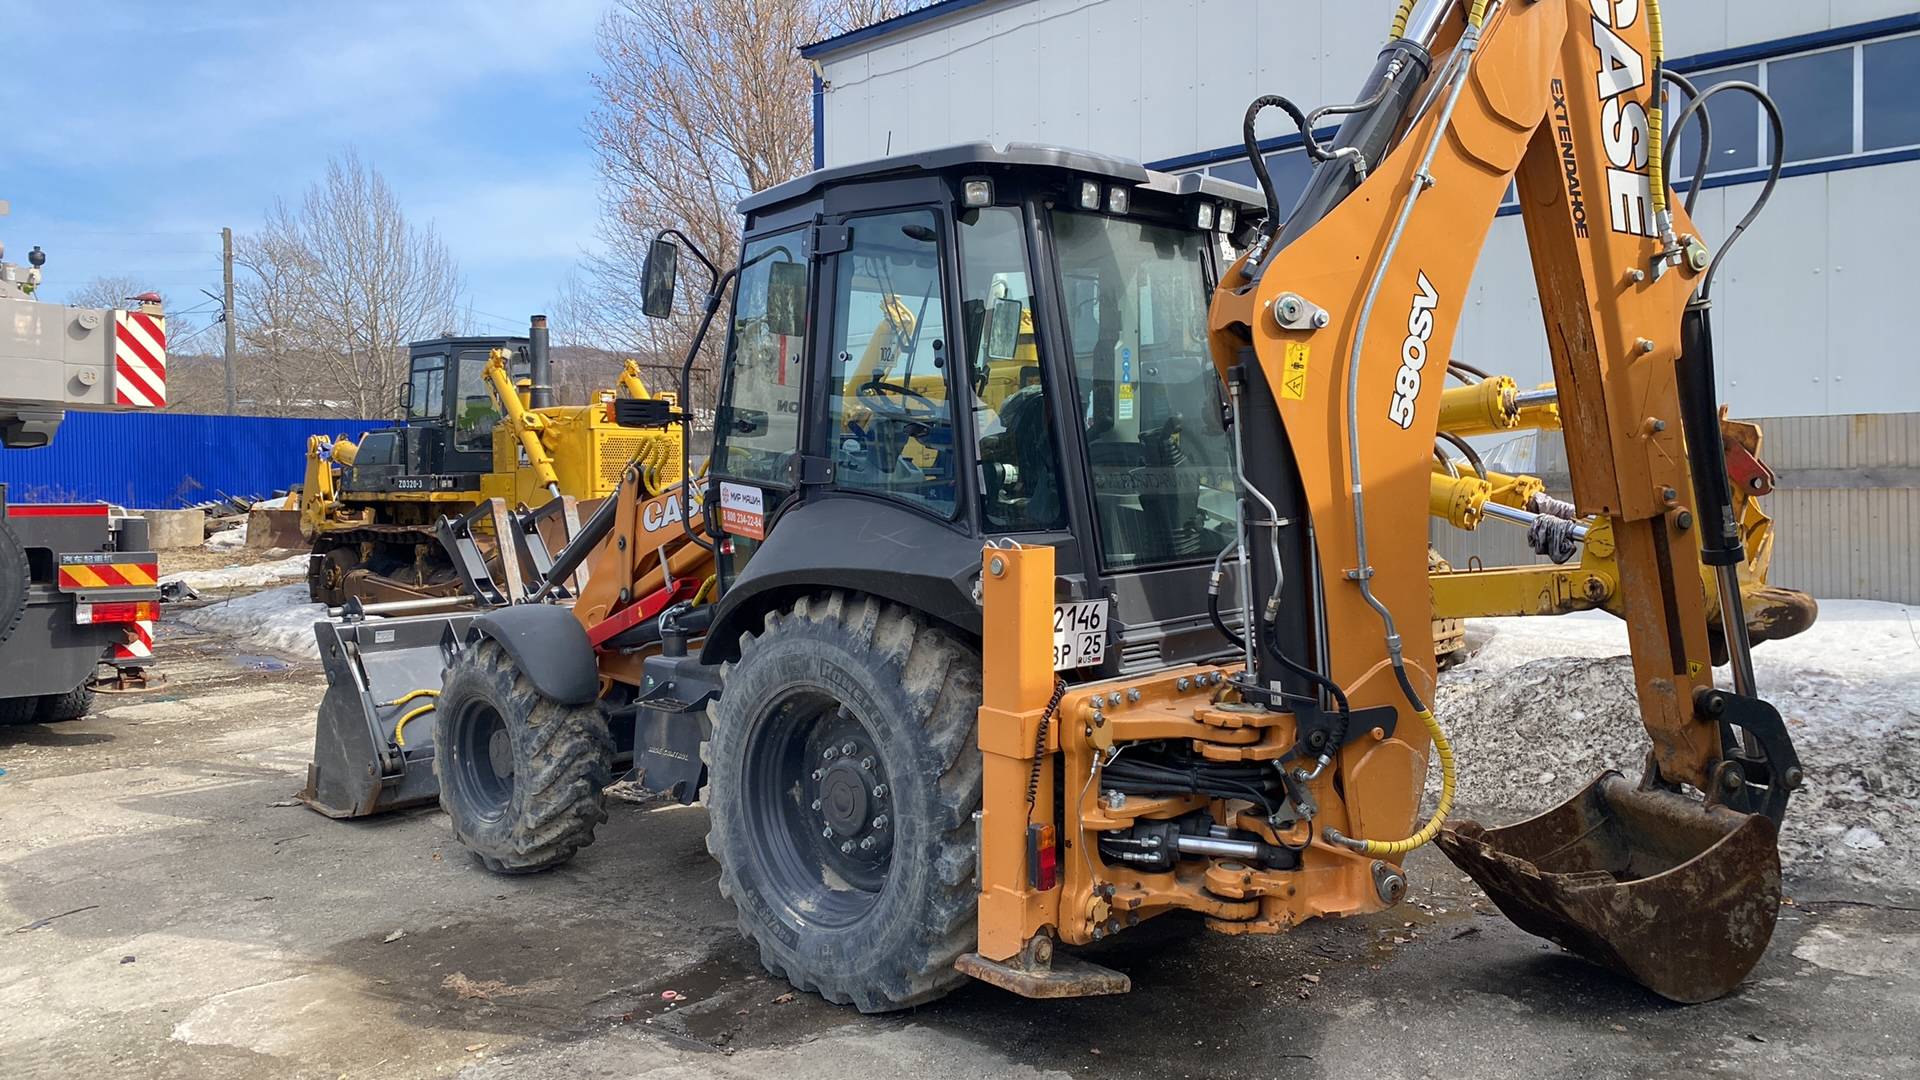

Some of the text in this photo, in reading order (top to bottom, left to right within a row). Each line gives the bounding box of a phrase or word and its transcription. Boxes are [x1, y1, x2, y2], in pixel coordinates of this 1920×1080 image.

[1551, 78, 1589, 239] EXTENDAHOE
[1388, 268, 1440, 430] 580SV
[1054, 603, 1100, 633] 2146
[1083, 634, 1102, 656] 25
